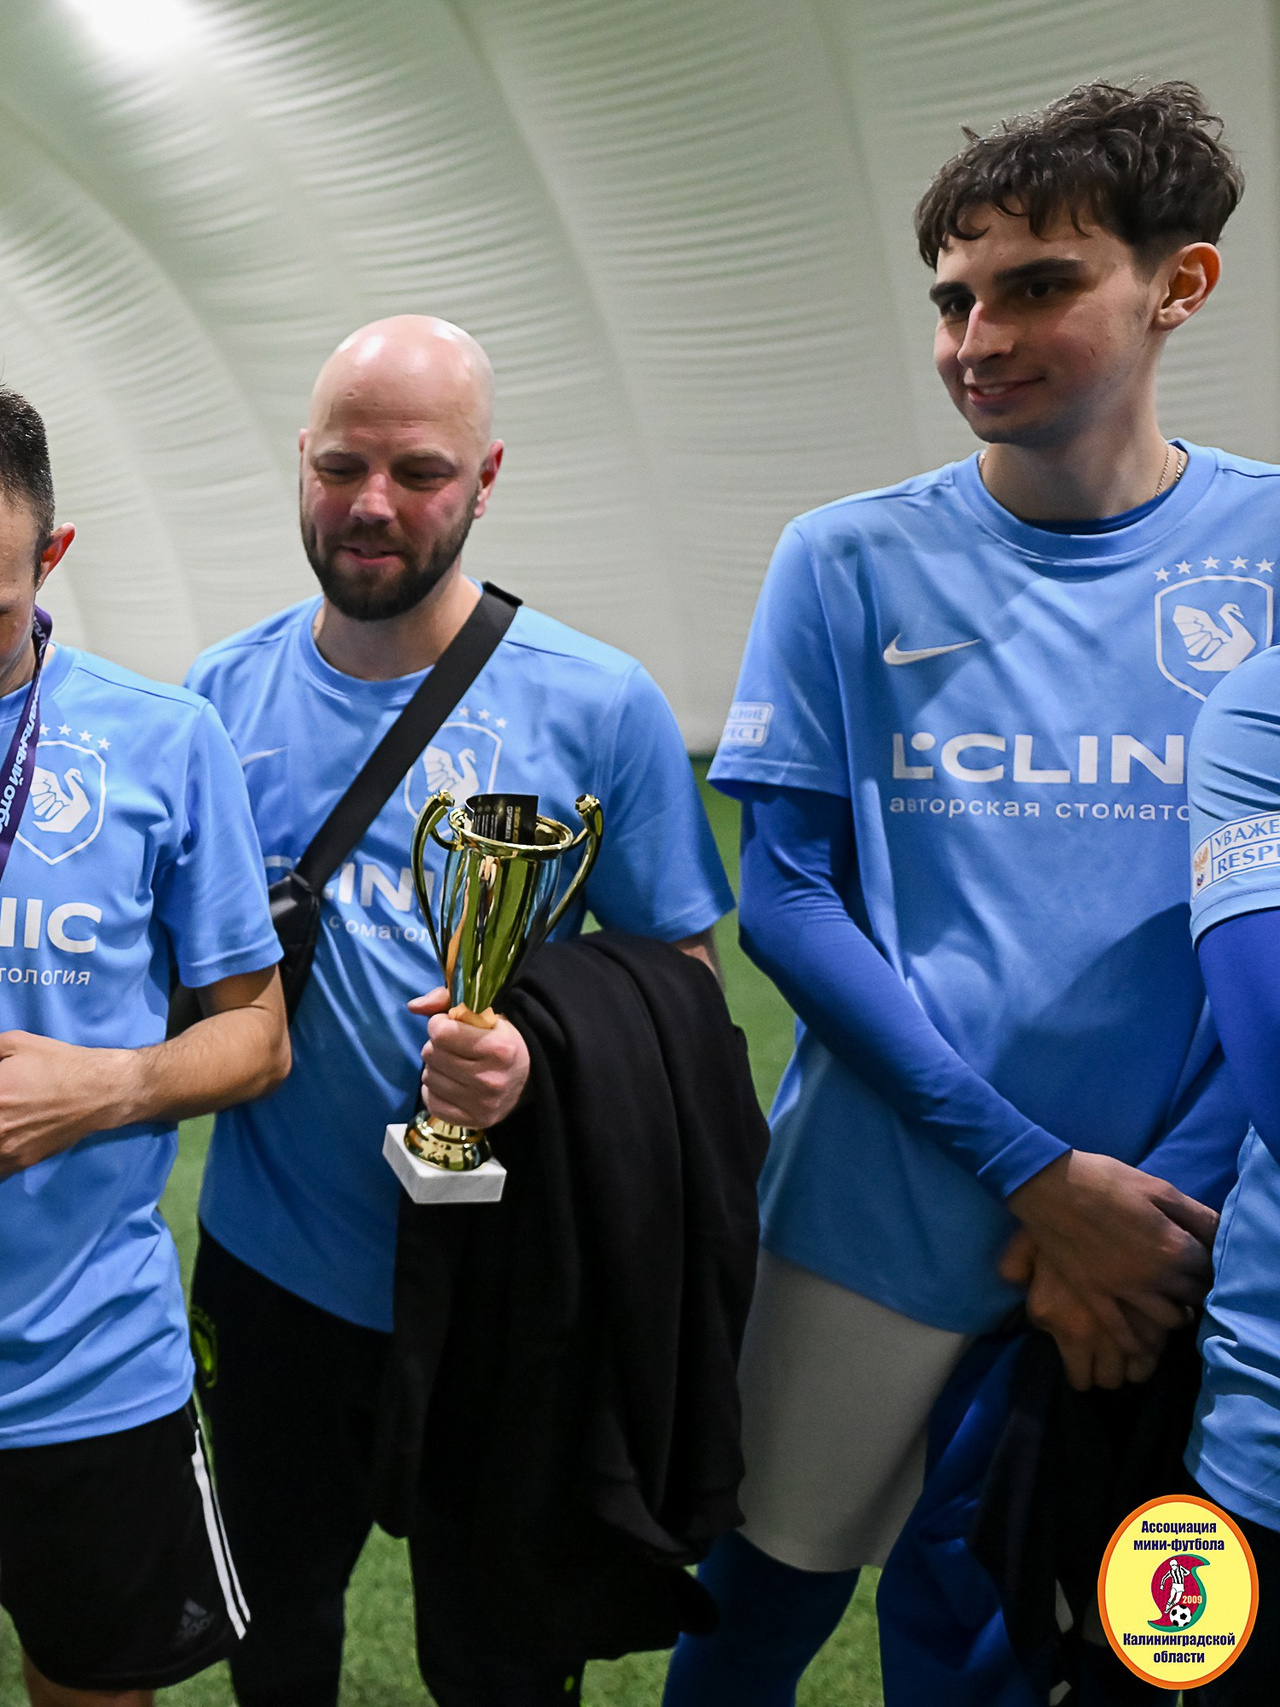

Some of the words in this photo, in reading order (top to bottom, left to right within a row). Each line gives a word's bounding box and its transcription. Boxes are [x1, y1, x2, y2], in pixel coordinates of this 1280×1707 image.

[889, 795, 1041, 822] авторская
[1055, 800, 1189, 822] стомато
[1215, 818, 1280, 850] УВАЖЕ
[1217, 844, 1280, 876] RESP
